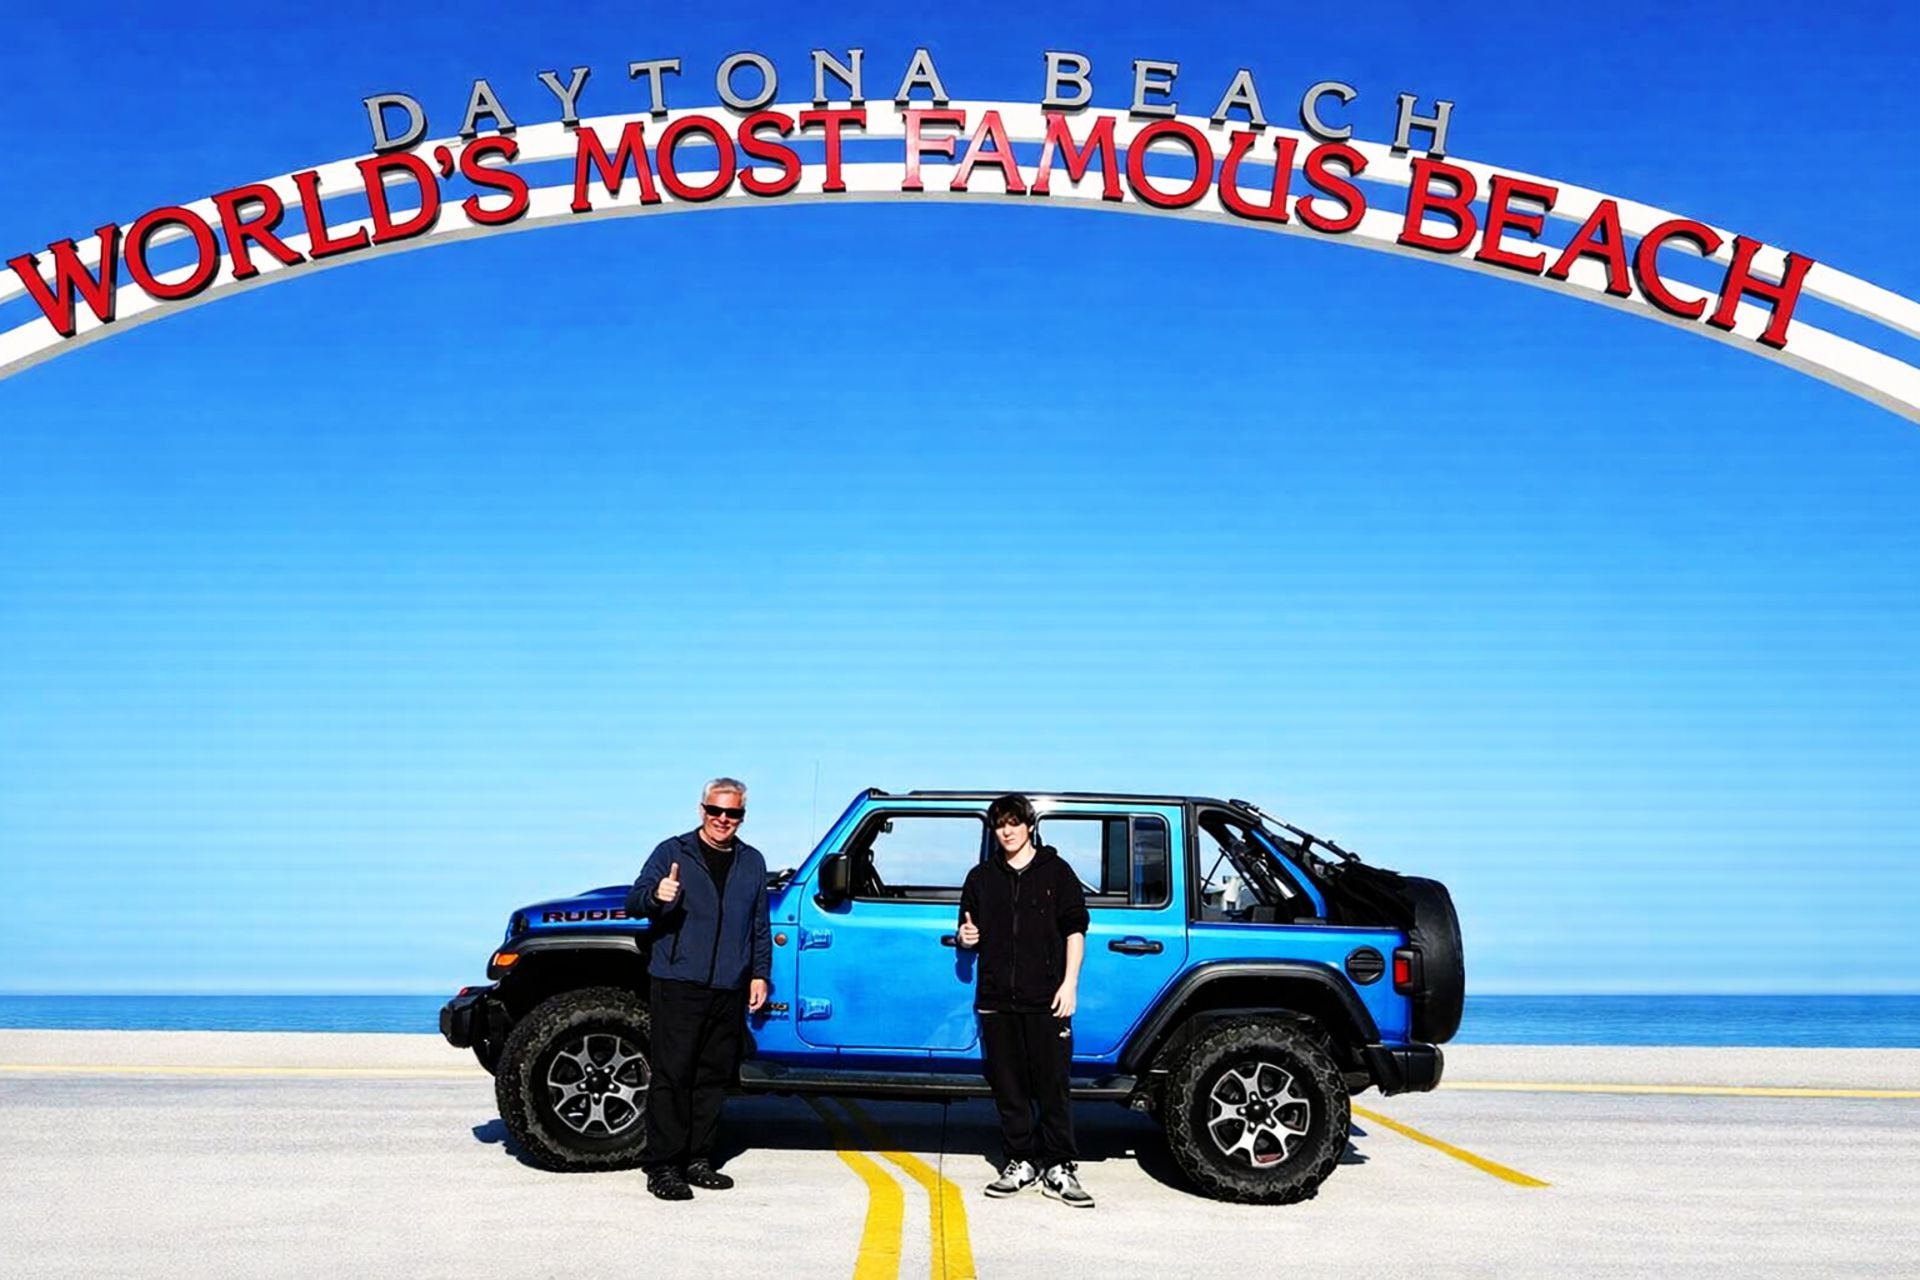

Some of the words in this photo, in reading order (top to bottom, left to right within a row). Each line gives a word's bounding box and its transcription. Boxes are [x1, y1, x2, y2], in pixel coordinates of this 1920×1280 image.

[363, 47, 949, 155] DAYTONA
[1042, 50, 1454, 160] BEACH
[7, 133, 529, 337] WORLD'S
[571, 107, 867, 214] MOST
[902, 107, 1368, 237] FAMOUS
[1398, 155, 1816, 350] BEACH
